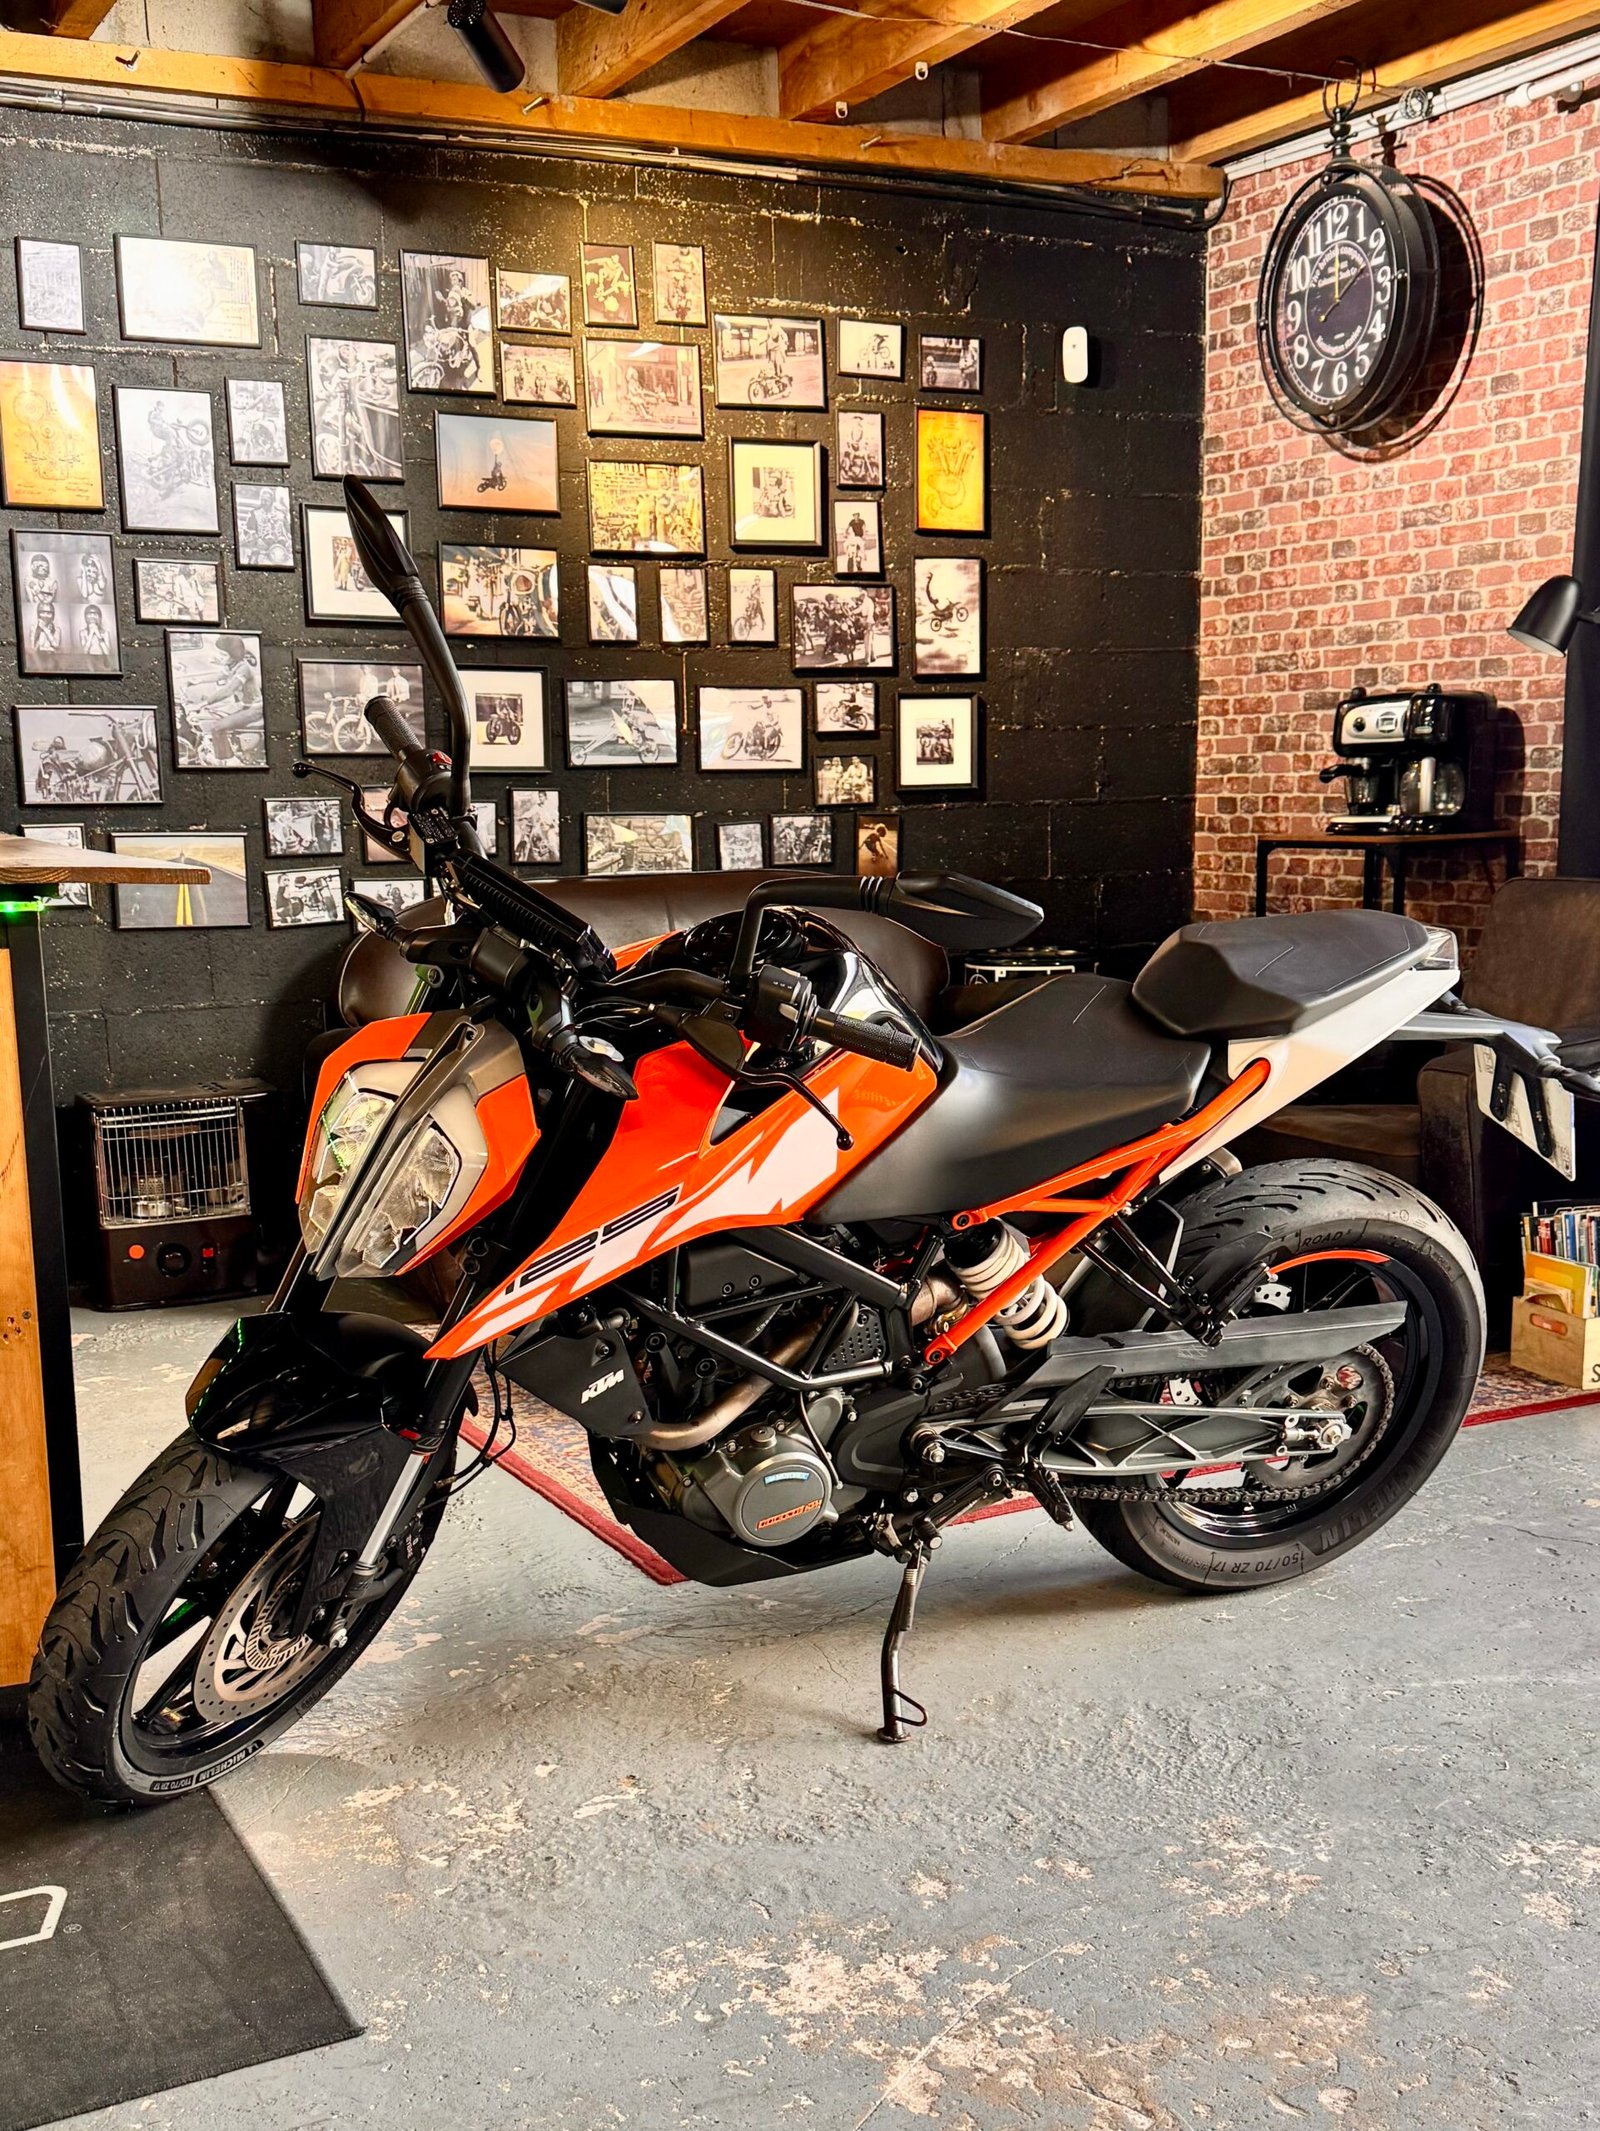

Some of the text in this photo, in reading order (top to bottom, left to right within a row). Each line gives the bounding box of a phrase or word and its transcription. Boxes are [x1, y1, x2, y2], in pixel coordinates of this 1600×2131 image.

[1307, 221, 1325, 259] 11
[1324, 203, 1350, 244] 12
[1356, 207, 1368, 242] 1
[1368, 227, 1387, 266] 2
[1289, 255, 1311, 294] 10
[1376, 265, 1391, 304] 3
[1287, 300, 1302, 333] 9
[1368, 308, 1387, 343] 4
[1293, 334, 1309, 369] 8
[1354, 342, 1371, 378] 5
[1310, 358, 1326, 393] 7
[1332, 360, 1348, 396] 6
[504, 1186, 680, 1296] 125
[1302, 1231, 1344, 1247] ROAD
[580, 1368, 625, 1405] KTM
[1210, 1560, 1227, 1573] 17
[1230, 1561, 1250, 1574] ZR
[1254, 1550, 1305, 1573] 150/70
[170, 1777, 192, 1790] 110/70
[199, 1750, 246, 1782] MICHELIN
